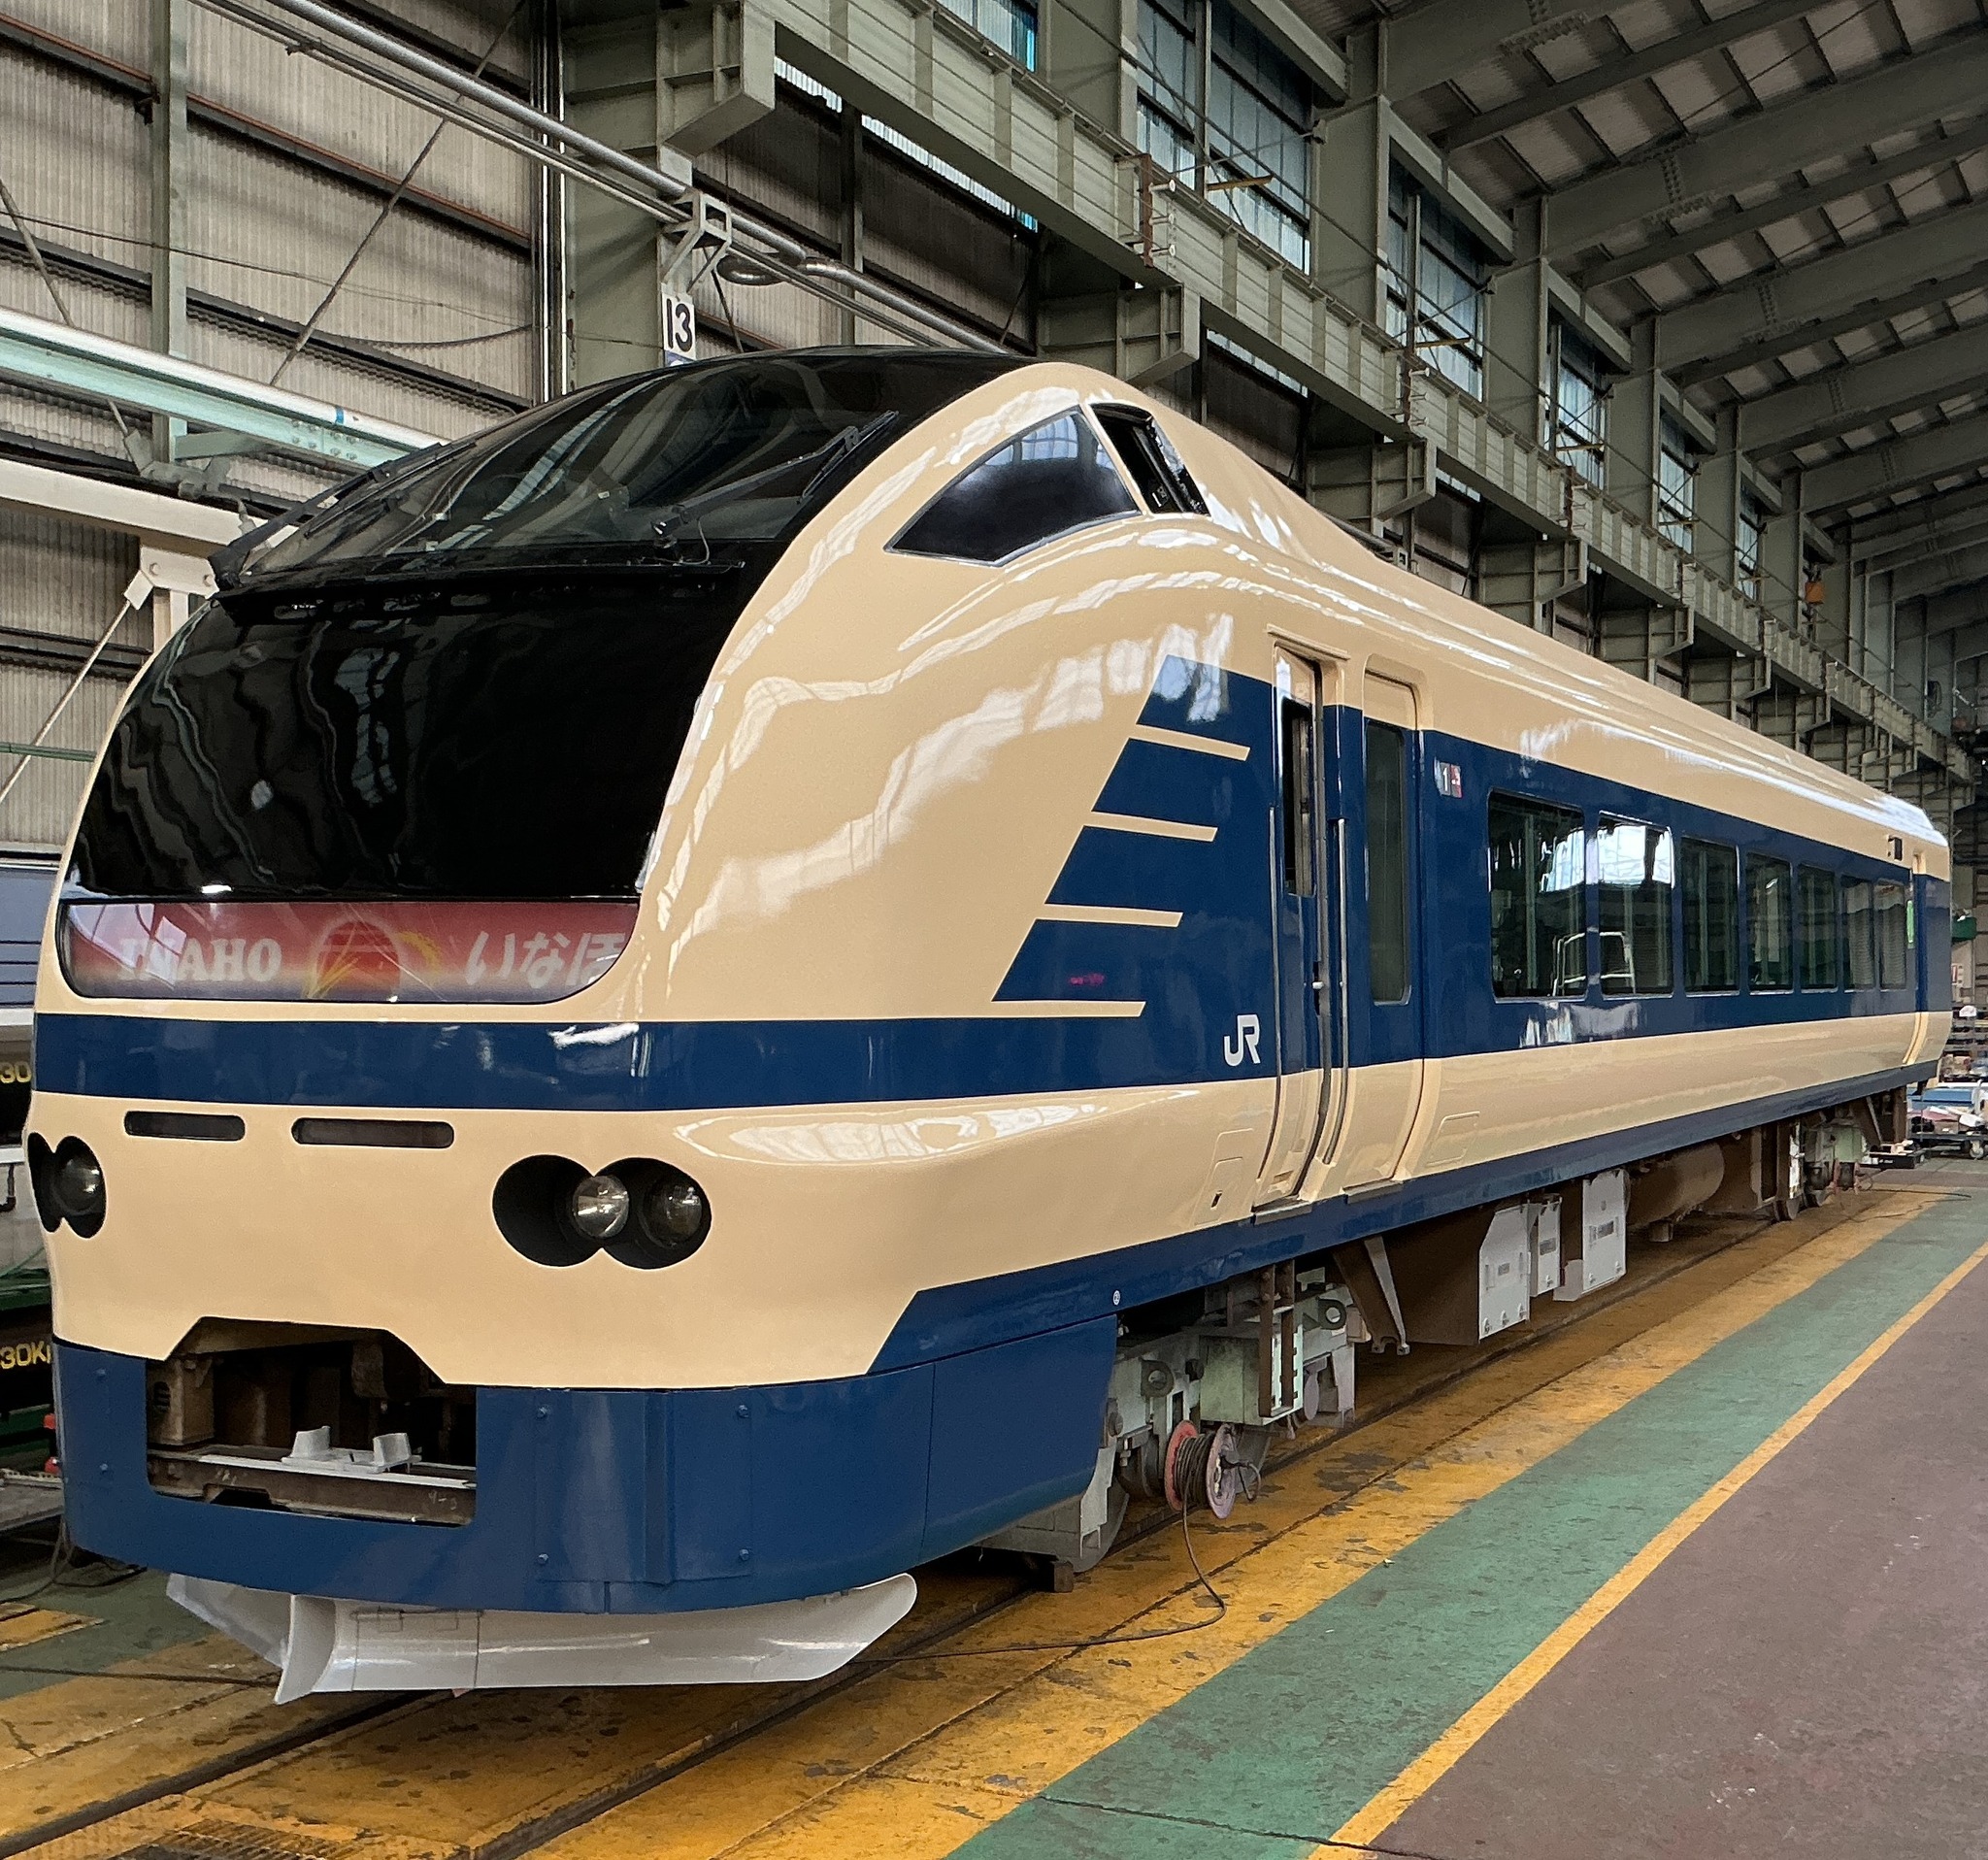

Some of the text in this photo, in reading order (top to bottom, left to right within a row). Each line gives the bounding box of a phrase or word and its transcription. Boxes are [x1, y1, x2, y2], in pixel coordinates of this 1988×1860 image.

[666, 298, 693, 352] 13
[1223, 1013, 1261, 1067] JR
[0, 1341, 52, 1370] 30K
